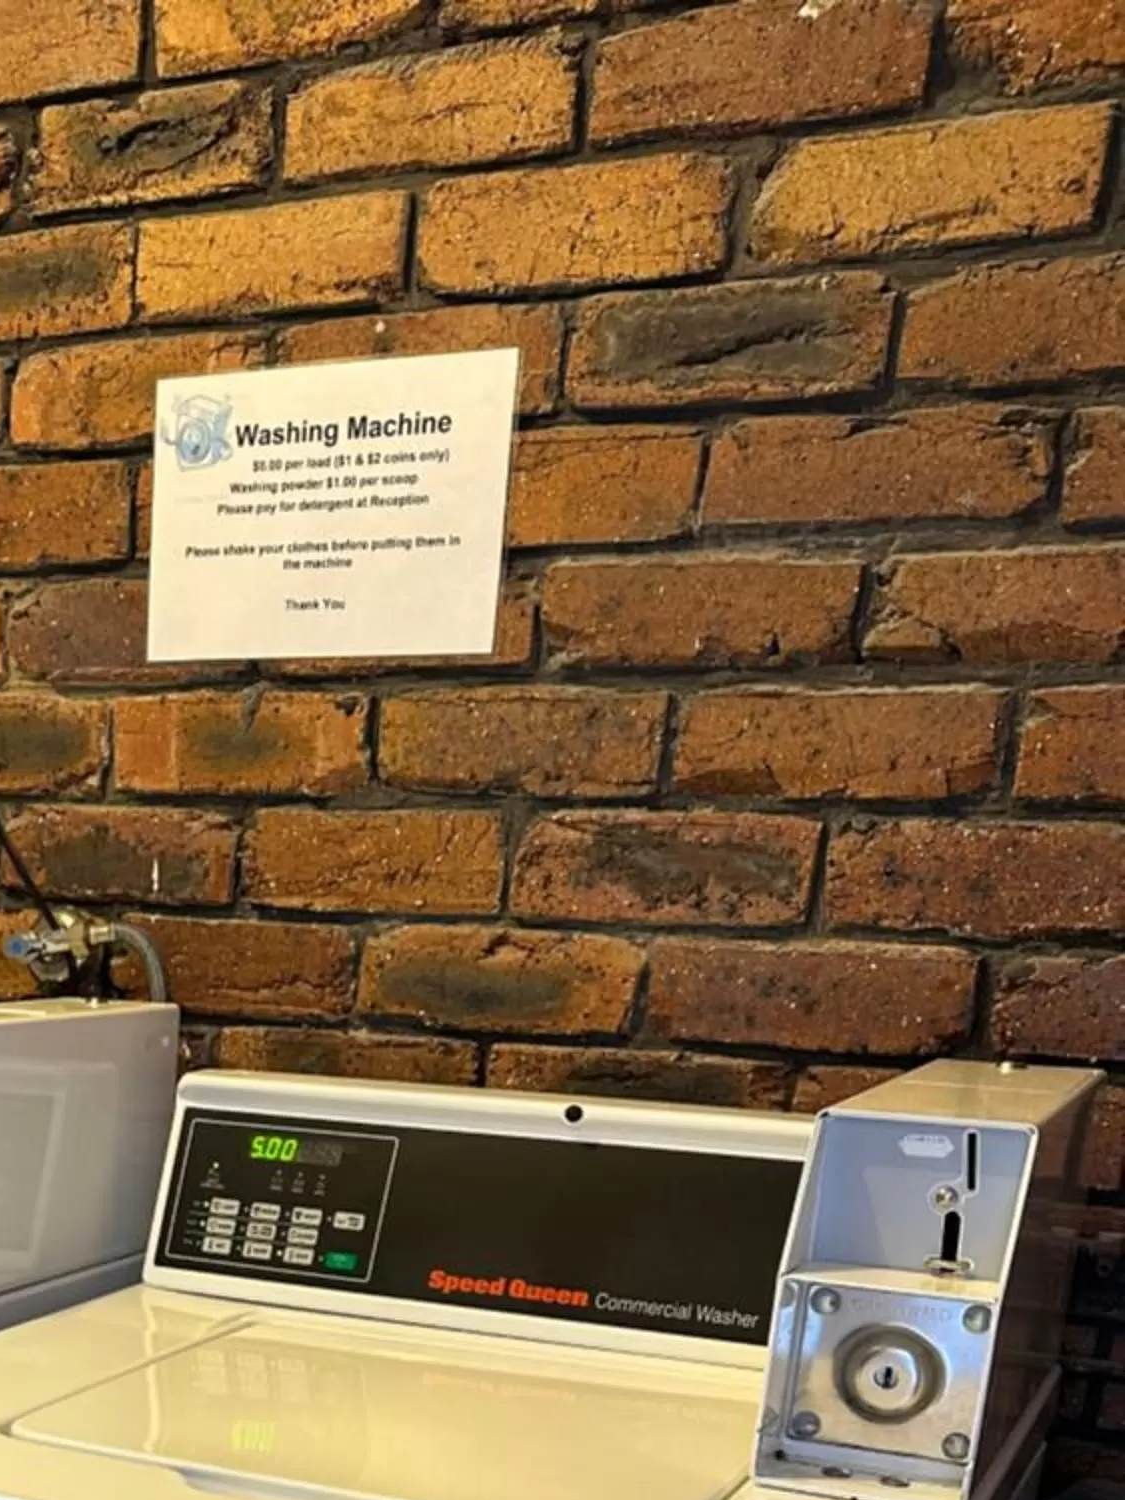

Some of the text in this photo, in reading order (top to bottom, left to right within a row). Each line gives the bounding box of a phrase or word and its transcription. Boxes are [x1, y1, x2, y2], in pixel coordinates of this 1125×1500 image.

[236, 411, 452, 447] Washing Machine
[285, 459, 304, 472] per
[307, 456, 331, 469] load
[334, 453, 351, 469] ($1
[355, 454, 364, 466] &
[367, 452, 381, 466] $2
[383, 450, 416, 464] coins
[419, 448, 450, 464] only)
[229, 473, 418, 495] Washing powder $1.00 per scoop
[217, 494, 429, 516] Please pay for detergent at Reception
[185, 534, 461, 558] Please shake your clothes before putting them in
[282, 557, 352, 570] the machine
[285, 598, 345, 611] Thank You
[428, 1269, 760, 1329] Speed Queen Commercial Washer
